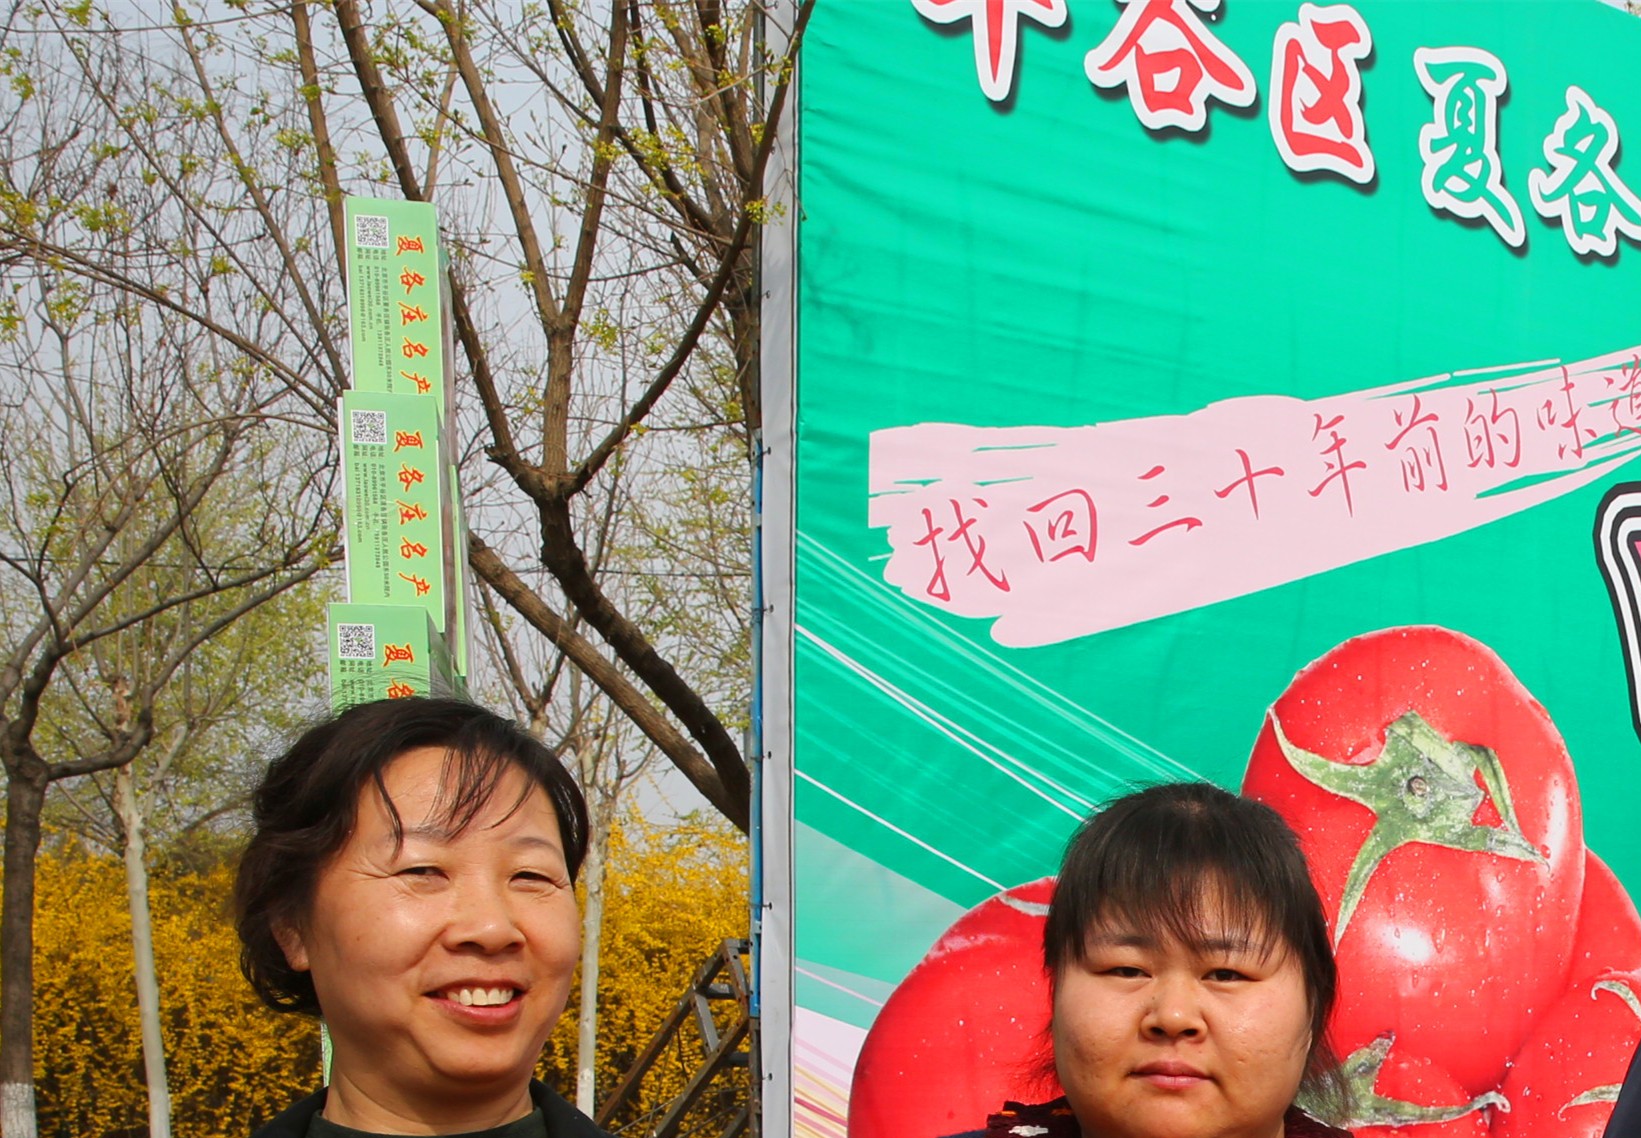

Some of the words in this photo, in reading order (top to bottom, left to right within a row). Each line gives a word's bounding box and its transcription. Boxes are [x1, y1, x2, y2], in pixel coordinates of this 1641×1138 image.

[396, 236, 432, 394] 夏各庄名产
[394, 431, 430, 596] 夏各庄名产
